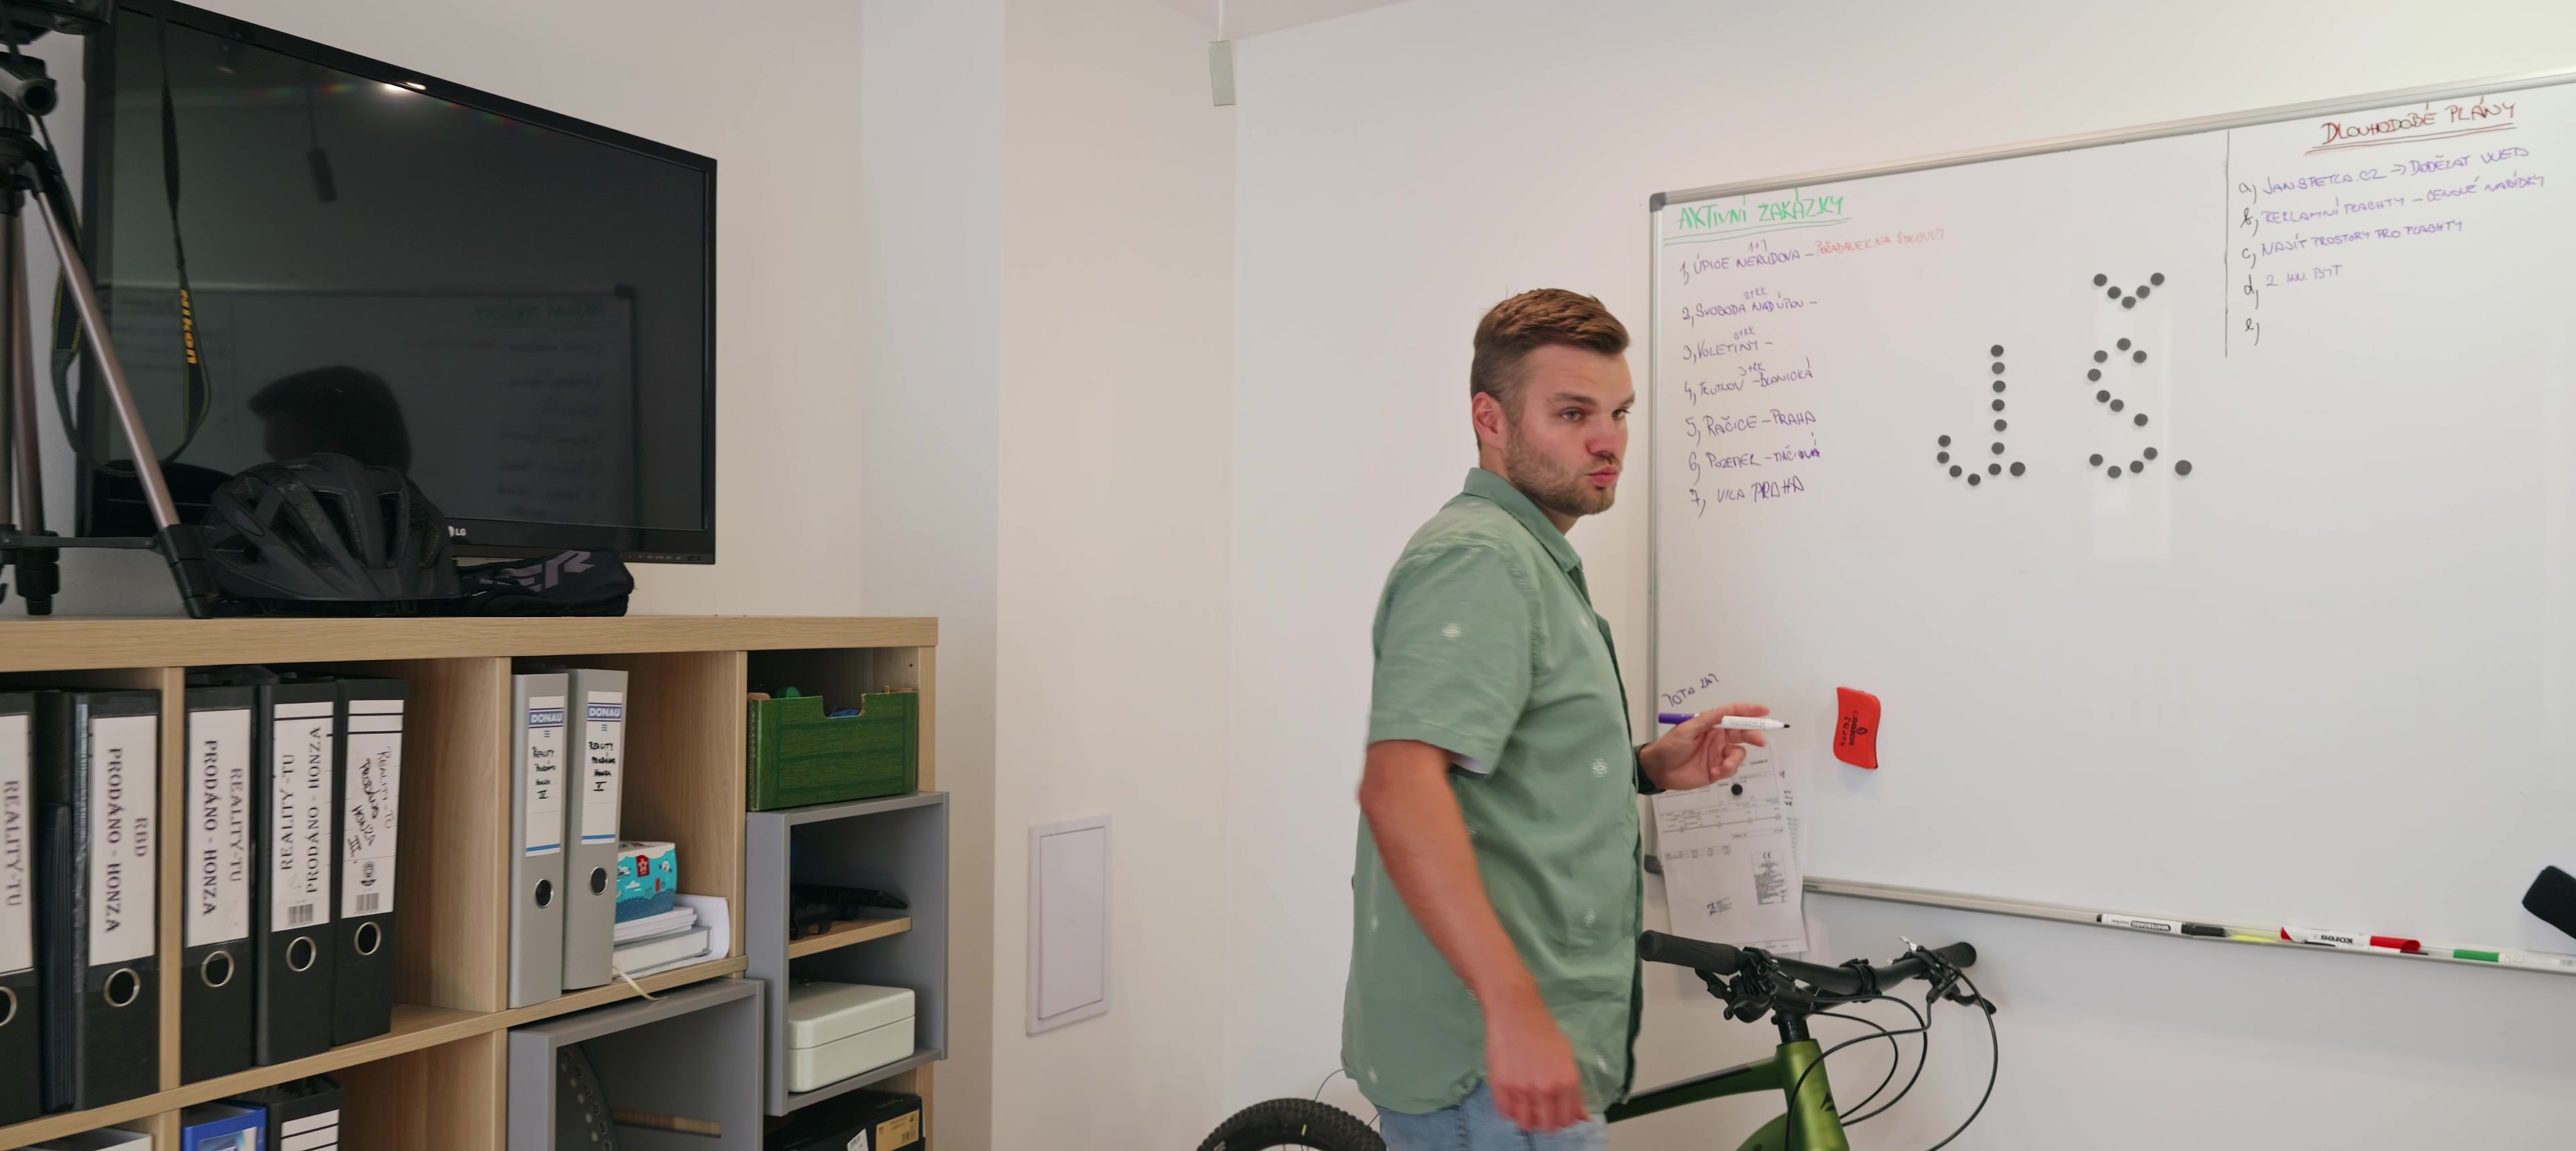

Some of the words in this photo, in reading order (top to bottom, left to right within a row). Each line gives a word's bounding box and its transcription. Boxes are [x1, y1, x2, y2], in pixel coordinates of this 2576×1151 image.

[2321, 102, 2438, 144] DLOUHODOBÉ
[2445, 95, 2516, 123] PLÁNY
[1676, 195, 1747, 229] AKTIVNÍ
[1758, 187, 1843, 221] ZAKÁZKY
[2374, 228, 2401, 239] PRO
[1770, 409, 1817, 426] PRAHA
[1751, 476, 1805, 503] PRAHA
[455, 528, 467, 536] LG
[531, 713, 564, 723] DONAU
[588, 708, 621, 717] DONAU
[309, 726, 321, 789] HONZA
[107, 747, 125, 844] PRODÁNO
[204, 740, 221, 832] PRODÁNO
[305, 806, 320, 893] PRODÁNO
[105, 863, 122, 934] HONZA
[203, 849, 218, 917] HONZA
